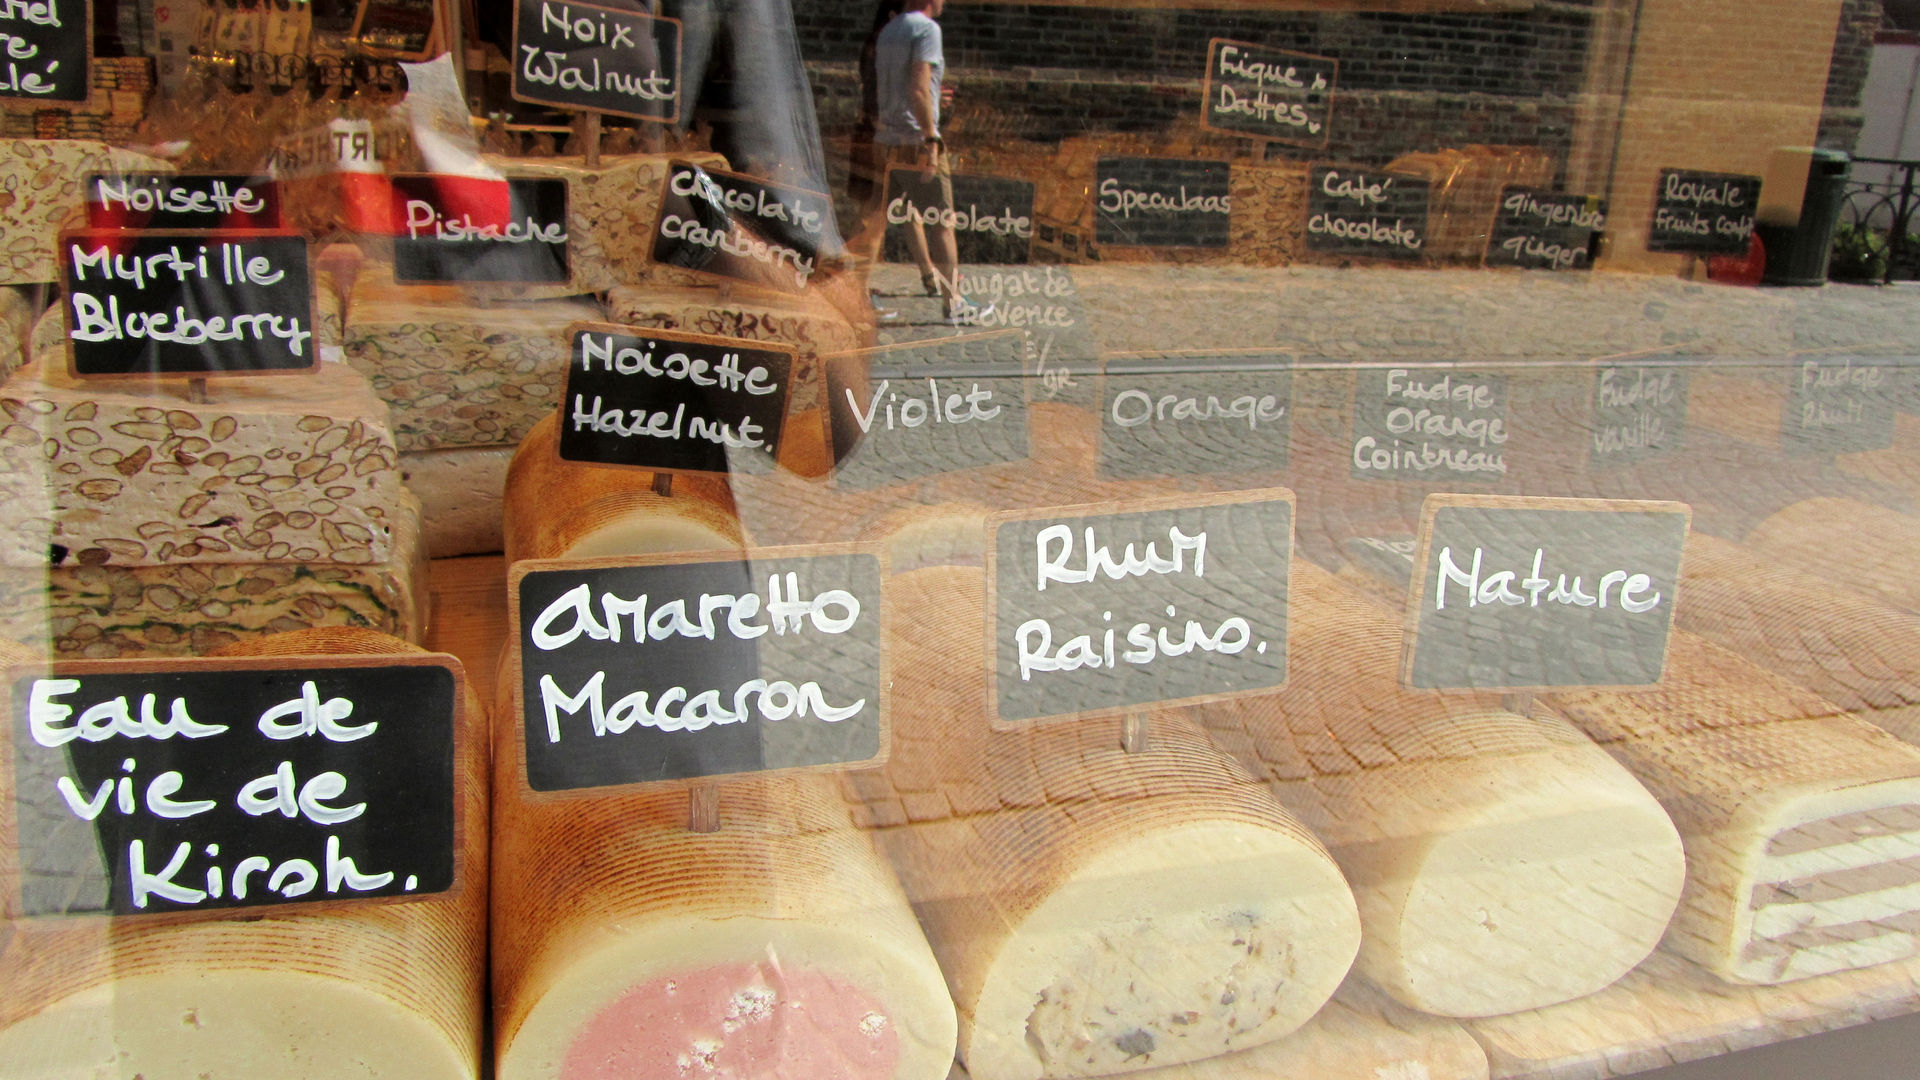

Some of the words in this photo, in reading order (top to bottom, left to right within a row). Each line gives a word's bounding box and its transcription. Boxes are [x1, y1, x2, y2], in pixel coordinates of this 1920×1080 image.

[542, 2, 634, 49] Noix
[520, 45, 678, 100] Walnut
[98, 178, 265, 214] Noisette
[1100, 178, 1231, 219] Speculaas
[1323, 171, 1392, 207] Café
[1666, 173, 1744, 208] Royale
[406, 200, 569, 242] Pistache
[71, 242, 285, 289] Myrtille
[933, 268, 1041, 304] Nougat
[1044, 266, 1075, 297] de
[71, 292, 311, 356] Blueberry
[581, 333, 777, 395] Noisette
[845, 379, 1001, 434] Violet
[1112, 389, 1285, 430] Orange
[1387, 369, 1494, 410] Fudge
[572, 394, 773, 453] Hazelnut.
[1386, 407, 1508, 447] Orange
[1354, 436, 1507, 473] Cointreau
[1037, 524, 1206, 591] Rhum
[1437, 547, 1660, 613] Nature
[29, 678, 229, 747] Eau
[258, 680, 378, 743] de
[540, 671, 865, 743] Macaron
[237, 760, 366, 825] de
